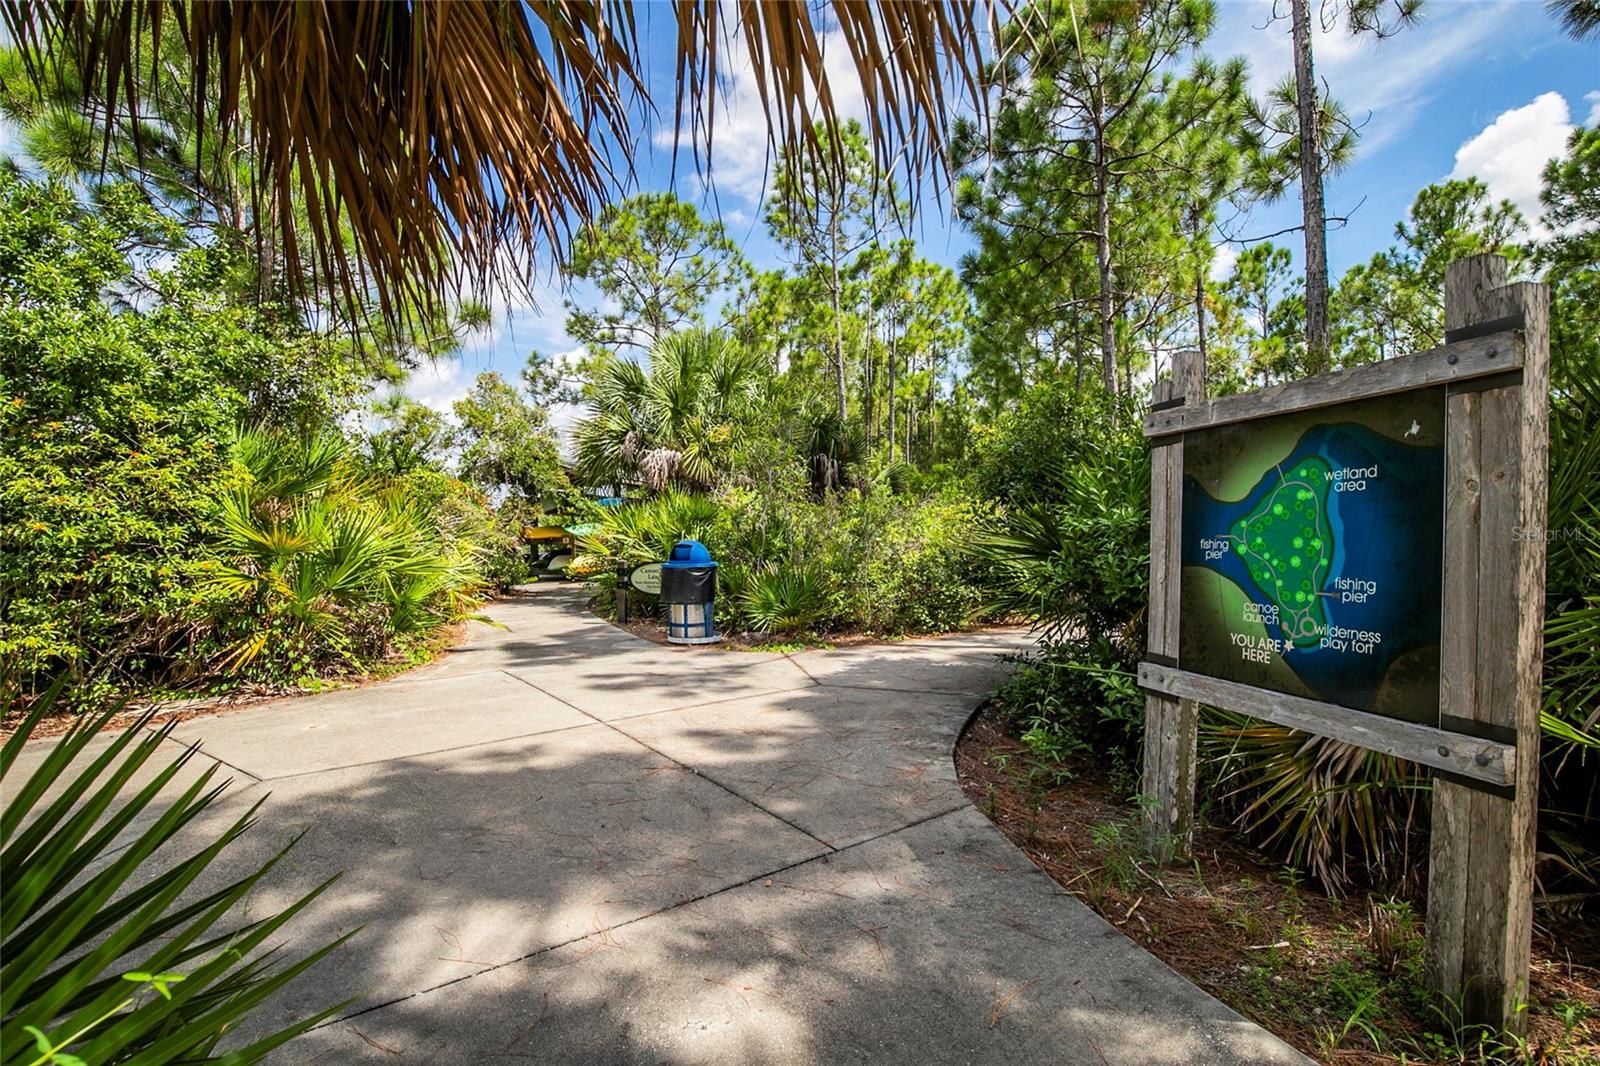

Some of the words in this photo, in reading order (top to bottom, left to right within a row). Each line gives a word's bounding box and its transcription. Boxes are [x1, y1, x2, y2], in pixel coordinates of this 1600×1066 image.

[1324, 465, 1378, 481] wetland
[1334, 480, 1366, 492] area
[1200, 538, 1229, 552] fishing
[1205, 549, 1224, 560] pier
[1334, 577, 1377, 595] fishing
[1342, 590, 1368, 604] pier
[1243, 602, 1279, 615] canoe
[1242, 612, 1279, 625] launch
[1314, 624, 1381, 644] wilderness
[1230, 632, 1255, 648] YOU
[1257, 638, 1281, 653] ARE
[1320, 637, 1349, 653] play
[1351, 640, 1374, 655] fort
[1242, 648, 1271, 664] HERE
